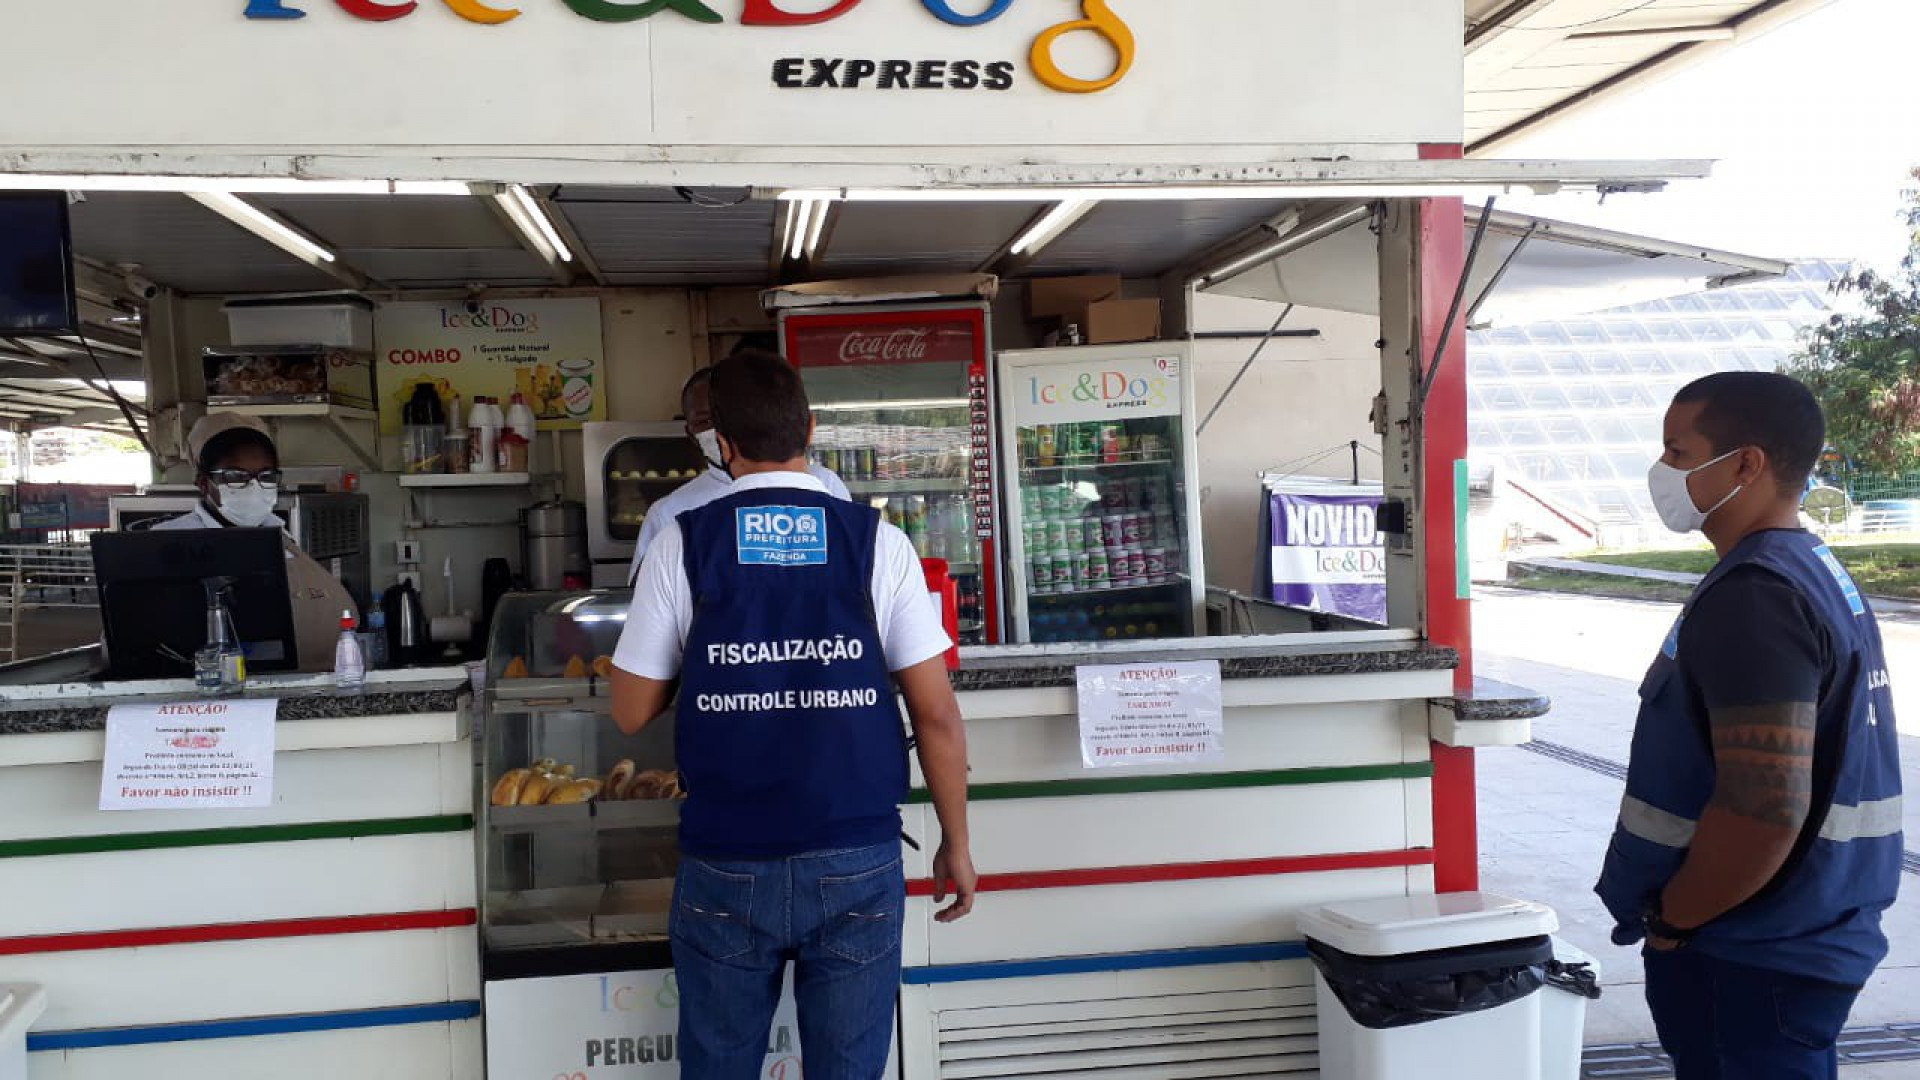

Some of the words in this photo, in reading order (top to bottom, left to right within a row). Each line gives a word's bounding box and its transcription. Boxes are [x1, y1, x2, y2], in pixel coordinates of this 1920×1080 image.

[772, 57, 1014, 90] EXPRESS
[388, 348, 462, 364] COMBO
[744, 513, 795, 535] RIO
[1287, 503, 1384, 545] NOVID
[745, 533, 818, 545] PREFEITURA
[763, 552, 806, 562] FAZENDA
[707, 634, 863, 666] FISCALIZAÇÃO
[1119, 667, 1177, 681] ATENÇÃO!
[697, 690, 796, 712] CONTROLE
[800, 688, 877, 709] URBANO
[157, 704, 228, 717] ATENÇÃO!
[1095, 746, 1128, 757] Favor
[121, 786, 161, 798] Favor
[164, 787, 189, 798] não
[192, 785, 240, 797] insistir
[586, 1034, 680, 1068] PERGU
